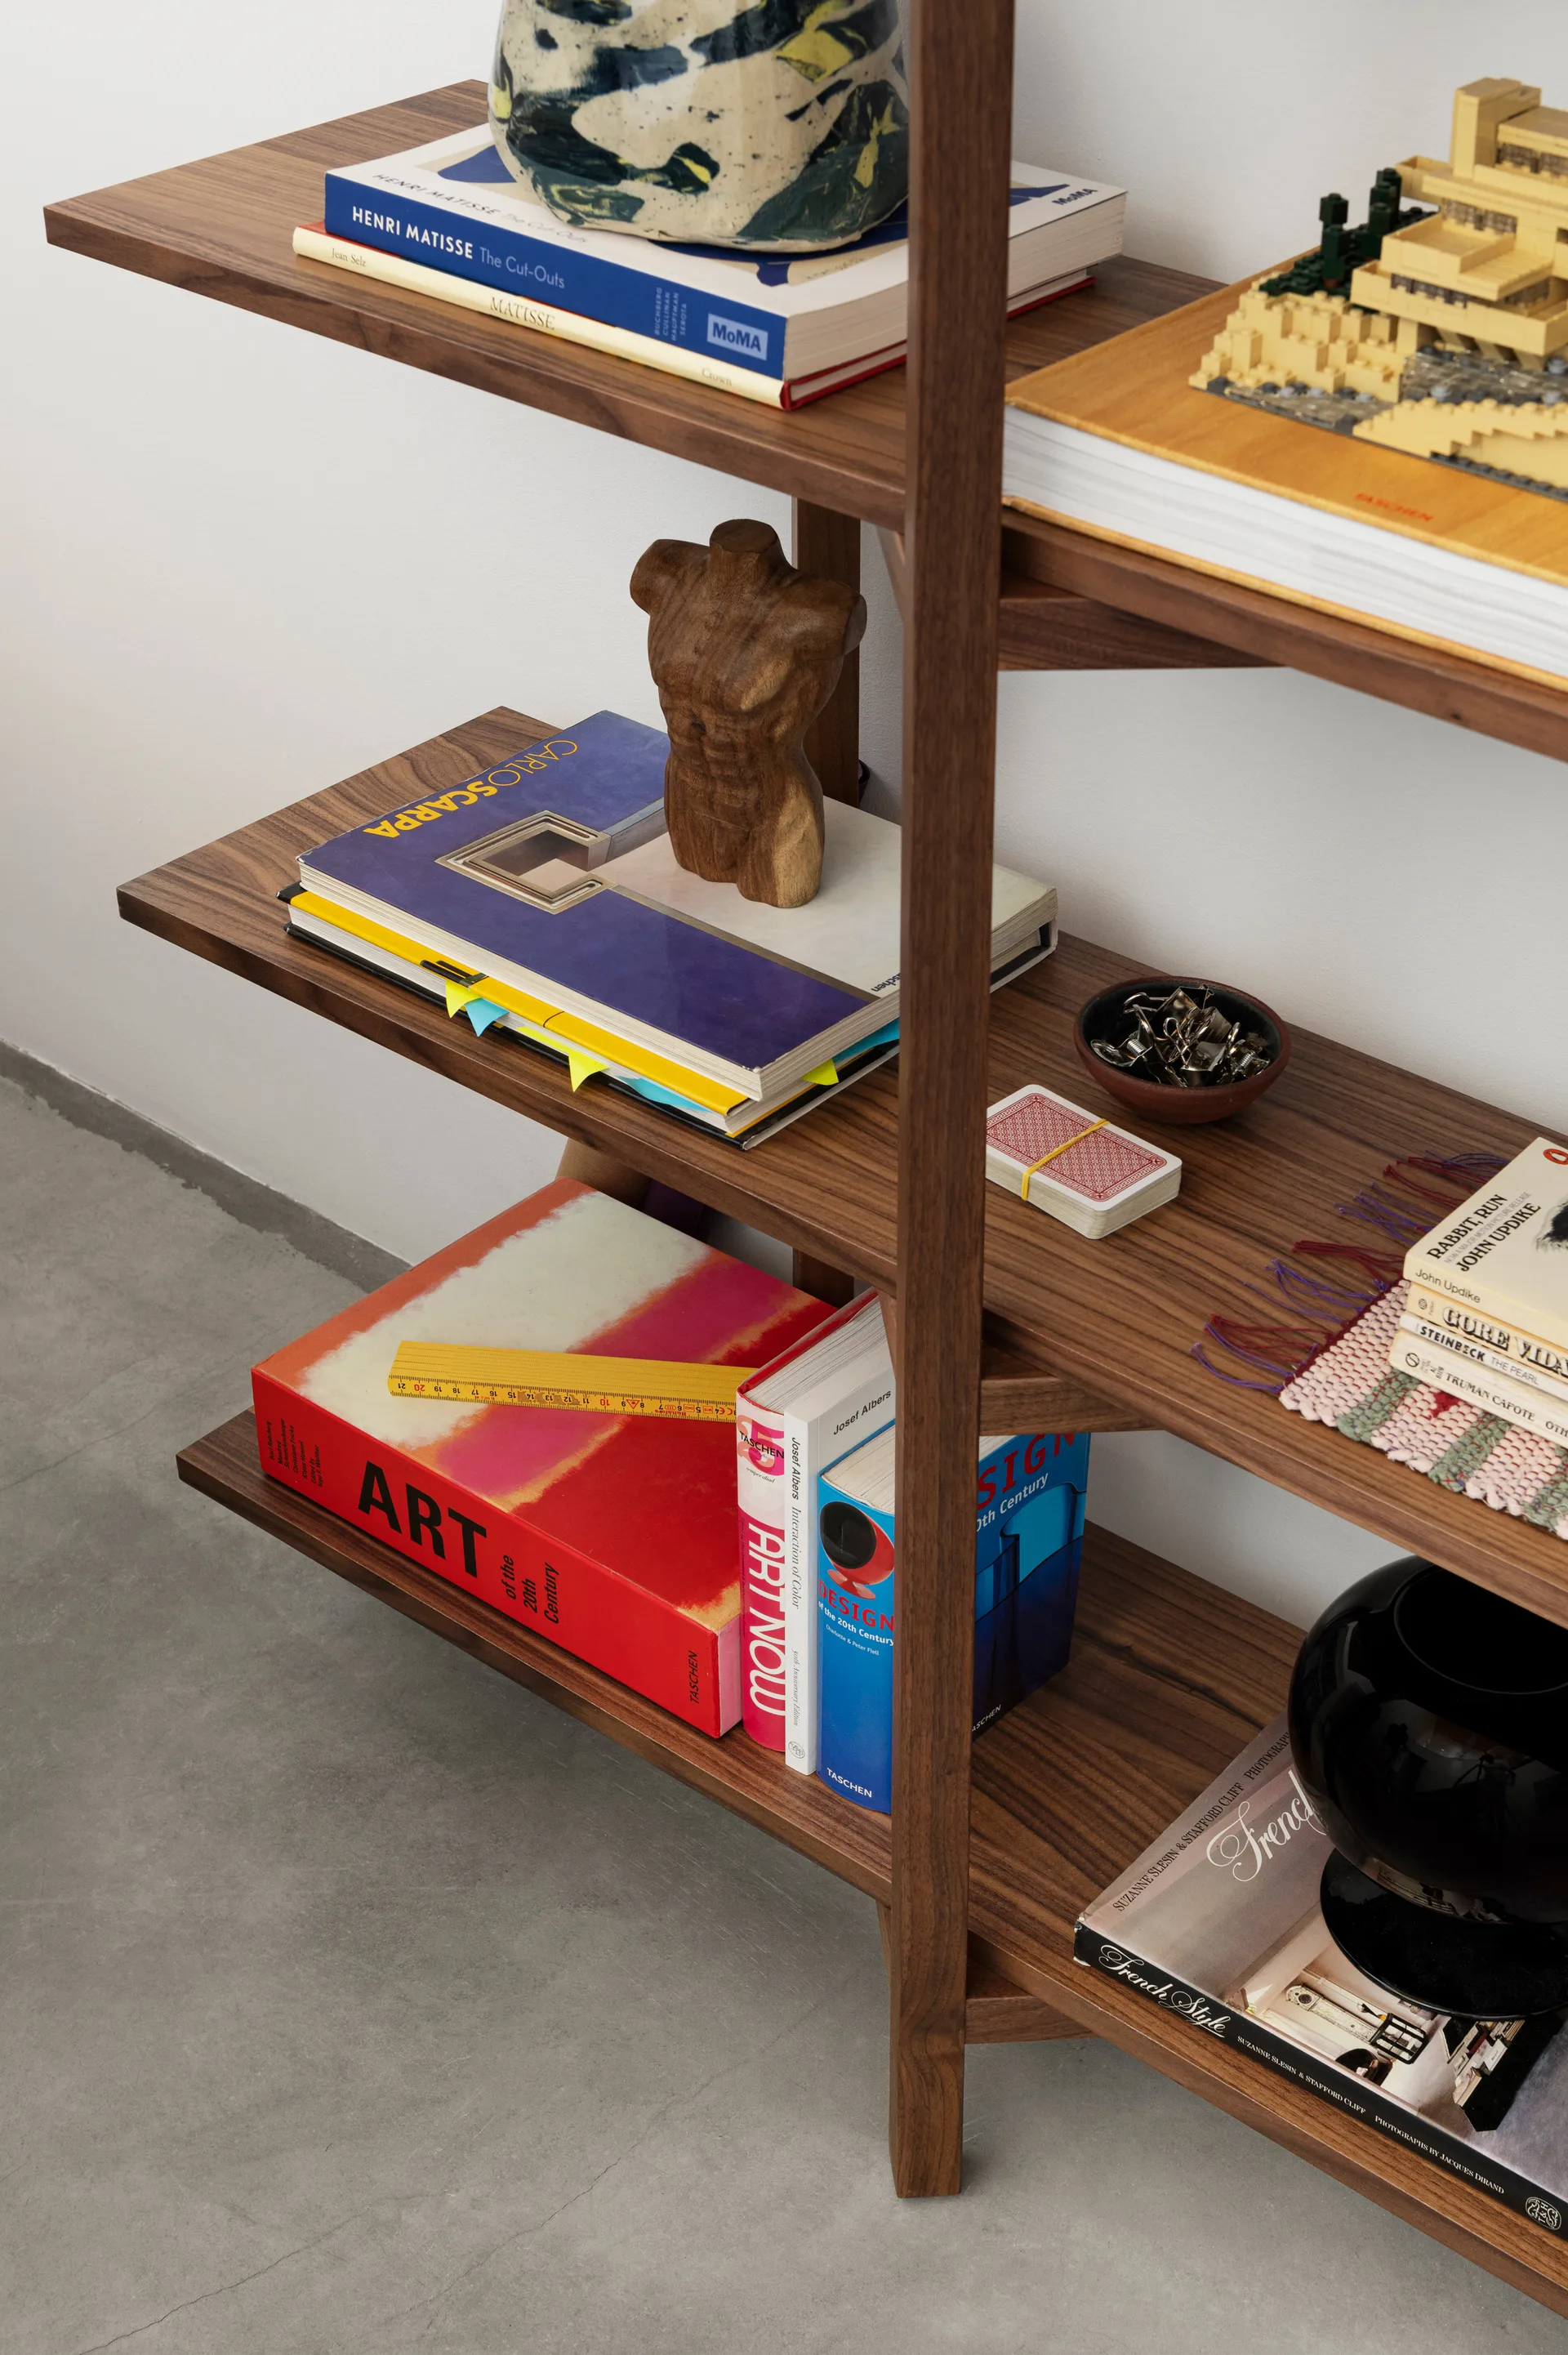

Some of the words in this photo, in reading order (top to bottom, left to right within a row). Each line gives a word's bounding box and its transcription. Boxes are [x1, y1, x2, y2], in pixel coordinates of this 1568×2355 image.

[372, 173, 423, 192] HENRI
[426, 190, 501, 215] MATISSE
[1051, 188, 1098, 205] MoMA
[331, 248, 348, 261] Jean
[351, 254, 366, 266] Selz
[352, 207, 400, 235] HENRI
[406, 224, 474, 260] MATISSE
[479, 247, 501, 268] The
[506, 256, 565, 289] Cut-Outs
[490, 297, 555, 331] MATISSE
[712, 321, 761, 352] MoMA
[702, 368, 733, 386] Crown
[1353, 493, 1434, 522] TASCHEN
[1426, 1216, 1484, 1260] RABBIT,
[1473, 1193, 1508, 1219] RUN
[1444, 1251, 1458, 1264] NOW
[1460, 1234, 1477, 1252] MAJOR
[1475, 1220, 1495, 1240] MOTION
[1491, 1207, 1511, 1226] PICTURE
[1509, 1191, 1532, 1211] RELEASE
[1456, 1239, 1496, 1272] JOHN
[1488, 1202, 1542, 1242] UPDIKE
[1415, 1269, 1441, 1287] John
[1443, 1279, 1481, 1304] Updike
[1442, 1306, 1511, 1352] GORE
[1420, 1326, 1486, 1363] STEINBECK
[1490, 1356, 1508, 1372] THE
[1510, 1365, 1539, 1385] PEARL
[413, 1384, 425, 1392] 20
[1446, 1372, 1491, 1401] TRUMAN
[1492, 1394, 1536, 1421] CAPOTE
[834, 1410, 859, 1435] Josef
[862, 1391, 891, 1416] Albers
[739, 1431, 784, 1459] TASCHEN
[791, 1437, 800, 1467] Josef
[791, 1467, 800, 1501] Albers
[1000, 1473, 1049, 1514] Century
[358, 1461, 487, 1578] ART
[791, 1506, 801, 1565] Interaction
[500, 1554, 514, 1581] the
[749, 1523, 786, 1612] ART
[791, 1563, 801, 1581] of
[501, 1579, 516, 1599] of
[521, 1578, 537, 1613] 20th
[544, 1562, 559, 1624] Century
[791, 1580, 801, 1609] Color
[818, 1578, 893, 1631] DESIGN
[818, 1601, 823, 1611] of
[824, 1608, 835, 1621] the
[838, 1617, 857, 1633] 20th
[858, 1628, 894, 1647] Century
[826, 1624, 846, 1642] Charlotte
[852, 1640, 866, 1651] Peter
[867, 1647, 880, 1656] Fiell
[688, 1650, 699, 1704] TASCHEN
[749, 1606, 786, 1716] NOW
[791, 1664, 800, 1702] Anniversary
[826, 1767, 872, 1798] TASCHEN
[1218, 1782, 1245, 1810] CLIFF
[1181, 1804, 1224, 1844] STAFFORD
[1147, 1848, 1180, 1878] SLESIN
[1176, 1841, 1187, 1851] &
[1112, 1874, 1154, 1911] SUZANNE
[1098, 1944, 1174, 2001] French
[1158, 1991, 1231, 2038] Style
[1237, 2036, 1271, 2060] SUZANNE
[1271, 2055, 1297, 2075] SLESIN
[1298, 2072, 1304, 2080] &
[1305, 2075, 1343, 2102] STAFFORD
[1343, 2097, 1366, 2115] CLIFF
[1374, 2115, 1428, 2151] PHOTOGRAPHS
[1429, 2147, 1440, 2157] BY
[1440, 2153, 1474, 2177] JACQUES
[1475, 2173, 1504, 2195] DIRAND
